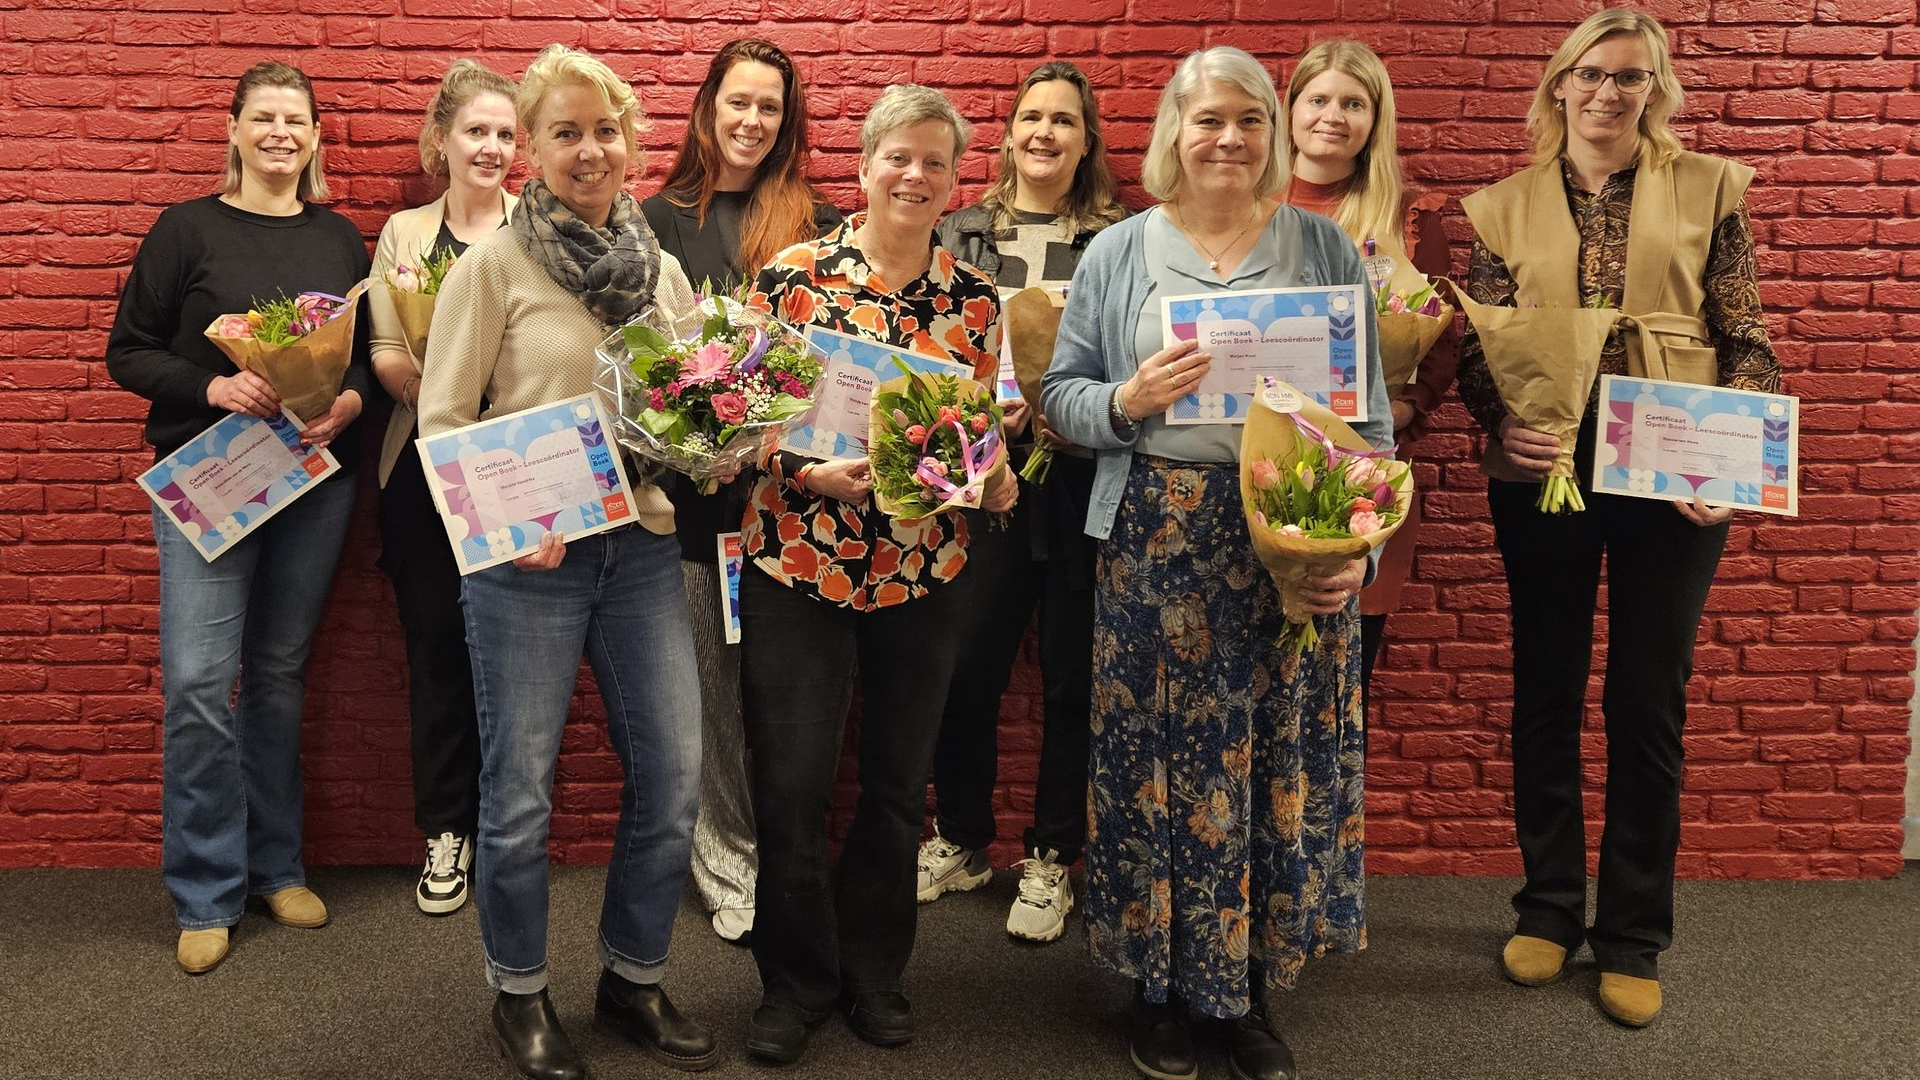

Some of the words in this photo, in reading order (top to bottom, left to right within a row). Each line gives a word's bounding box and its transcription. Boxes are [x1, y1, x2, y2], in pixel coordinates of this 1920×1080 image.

[1260, 335, 1324, 343] Leescoördinator
[1332, 347, 1353, 355] Open
[836, 378, 855, 389] Open
[837, 371, 873, 386] Certificaat
[1645, 413, 1686, 424] Certificaat
[1645, 420, 1667, 429] Open
[1667, 423, 1687, 431] Boek
[1695, 426, 1757, 440] Leescoördinator
[1765, 445, 1786, 454] Open
[193, 474, 210, 490] Open
[209, 467, 224, 479] Boek
[227, 433, 271, 466] Leescoördinator
[590, 451, 608, 462] Open
[1766, 452, 1785, 460] Boek
[474, 457, 513, 473] Certificaat
[477, 470, 499, 482] Open
[499, 464, 517, 475] Boek
[523, 446, 580, 468] Leescoördinator
[592, 457, 609, 467] Boek
[189, 462, 220, 485] Certificaat
